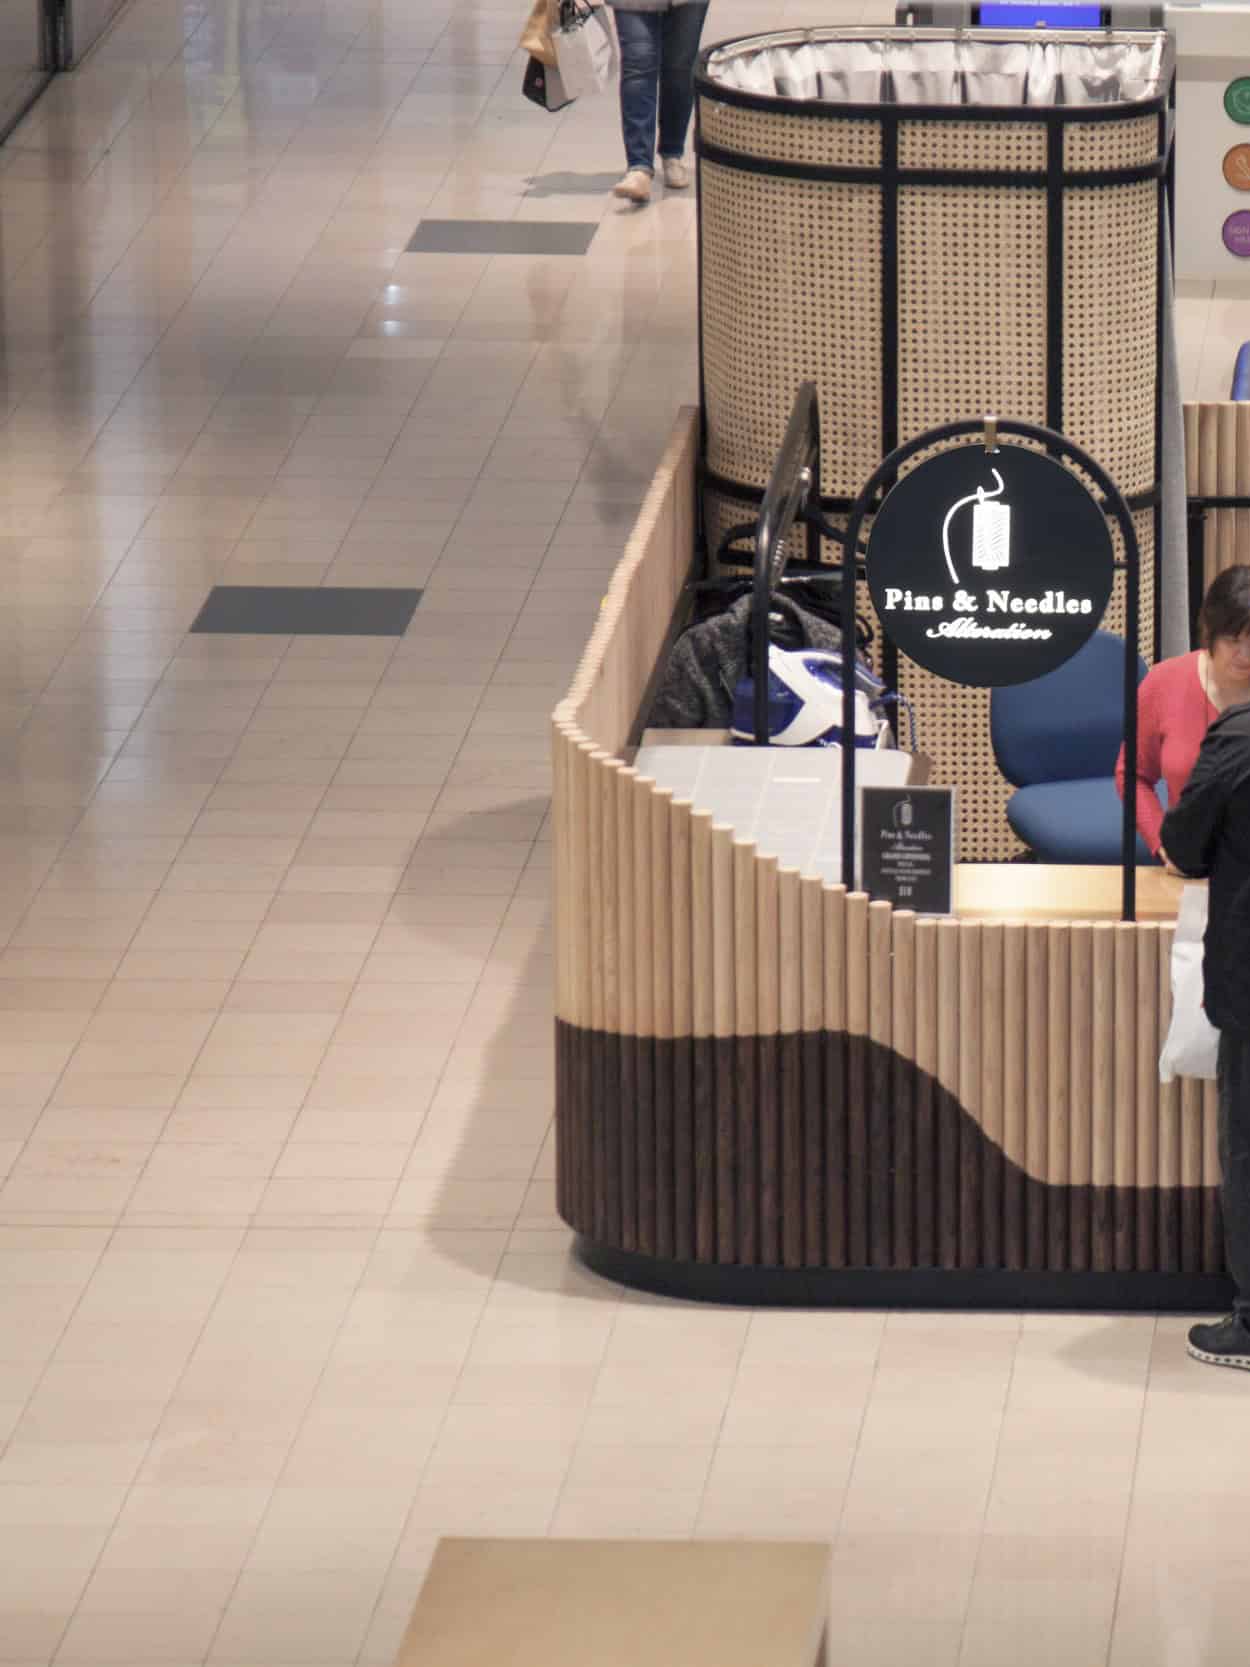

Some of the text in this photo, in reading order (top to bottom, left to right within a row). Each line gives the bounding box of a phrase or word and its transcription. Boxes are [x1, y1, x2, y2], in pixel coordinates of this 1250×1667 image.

[884, 588, 1093, 614] Pins & Needles
[926, 617, 1053, 640] Alteration
